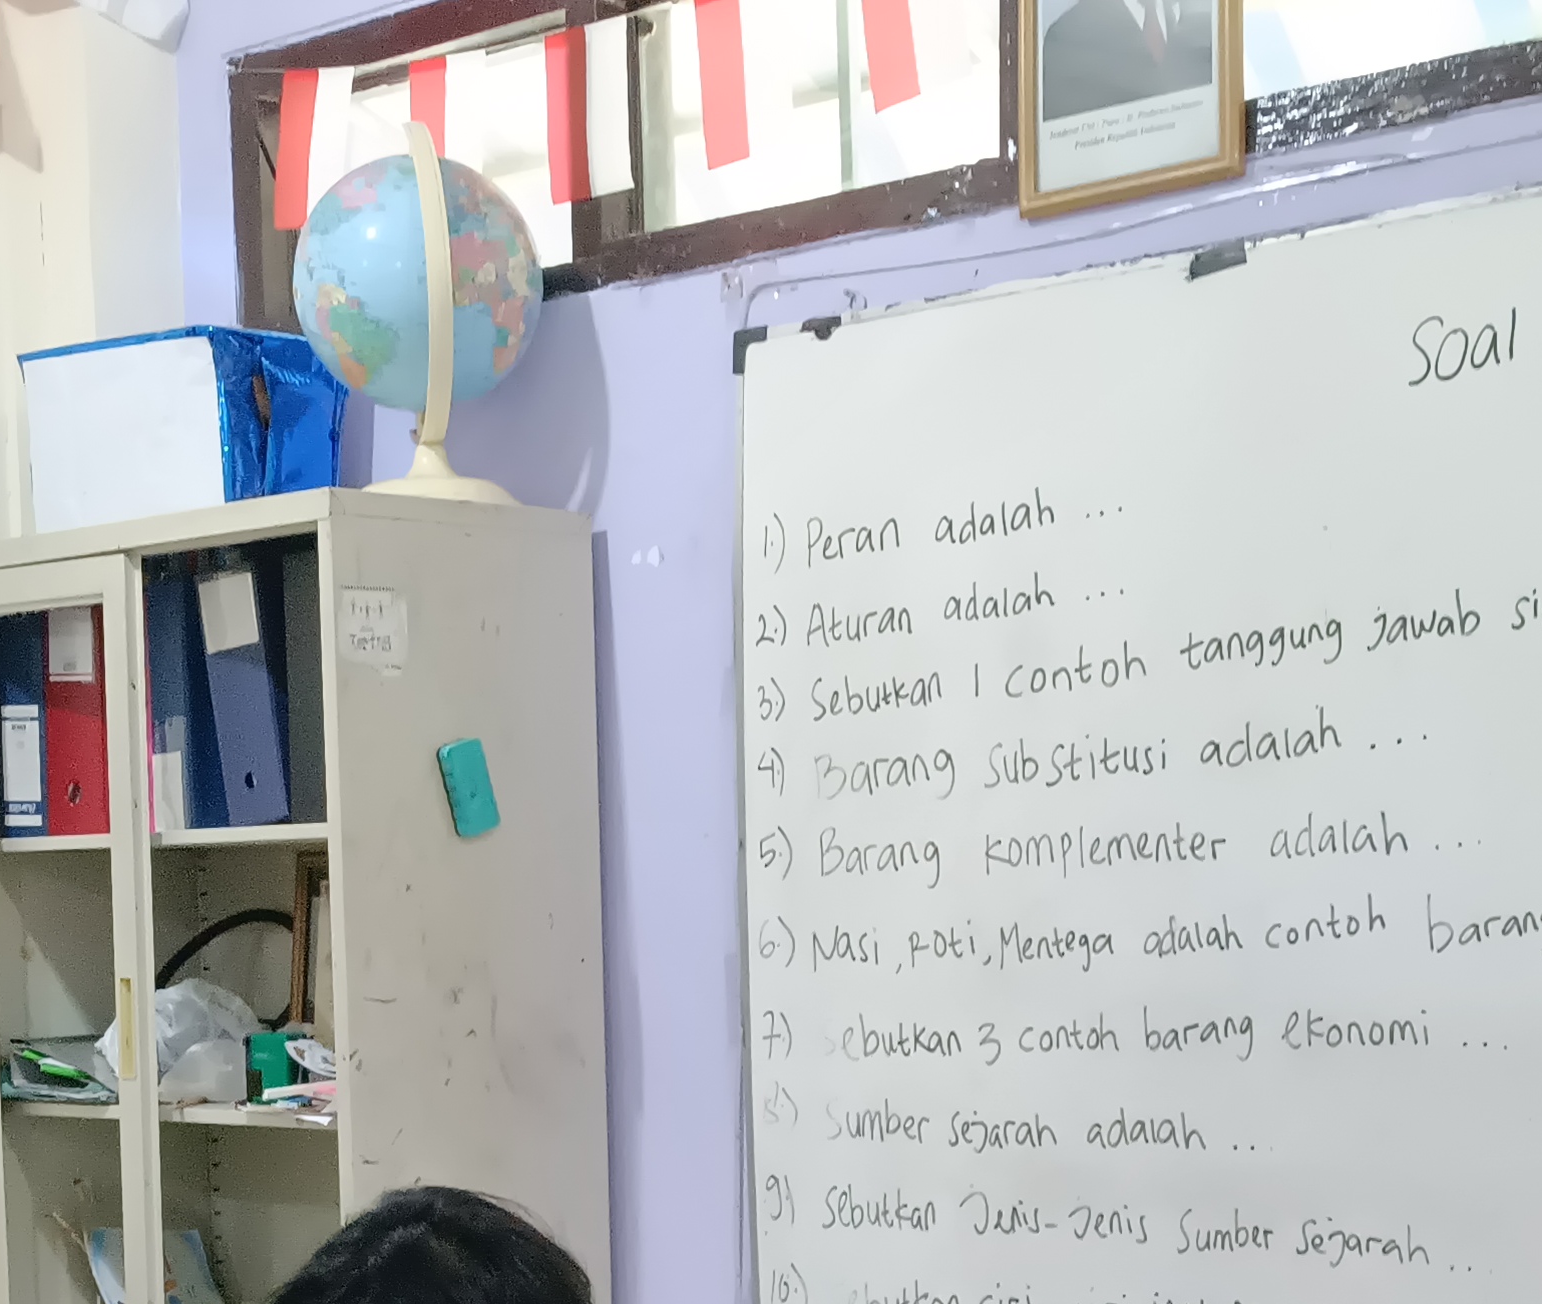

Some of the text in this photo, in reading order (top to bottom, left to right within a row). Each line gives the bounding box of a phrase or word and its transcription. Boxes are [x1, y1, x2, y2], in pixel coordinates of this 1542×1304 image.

[1408, 306, 1516, 387] Soal
[807, 516, 900, 569] Peran
[935, 486, 1055, 545] adalah
[807, 602, 913, 648] Aturan
[944, 570, 1056, 621] adalah
[811, 671, 942, 722] Sebutkan
[1005, 639, 1147, 698] contoh
[1180, 615, 1343, 670] tanggung
[1367, 587, 1481, 652] jawab
[814, 748, 955, 800] Barang
[1200, 704, 1342, 768] adalah
[820, 826, 940, 889] Barang
[1270, 810, 1408, 859] adalah
[1000, 921, 1114, 973] Mentega
[1143, 913, 1243, 959] adalah
[1265, 892, 1386, 949] contoh
[978, 1022, 1001, 1066] 3
[1019, 1011, 1119, 1053] contoh
[1143, 1005, 1253, 1062] barang
[1281, 1008, 1429, 1050] ekonomi
[1087, 1107, 1206, 1151] adalah
[822, 1183, 936, 1232] Sebutkan
[1176, 1208, 1274, 1255] Sumber
